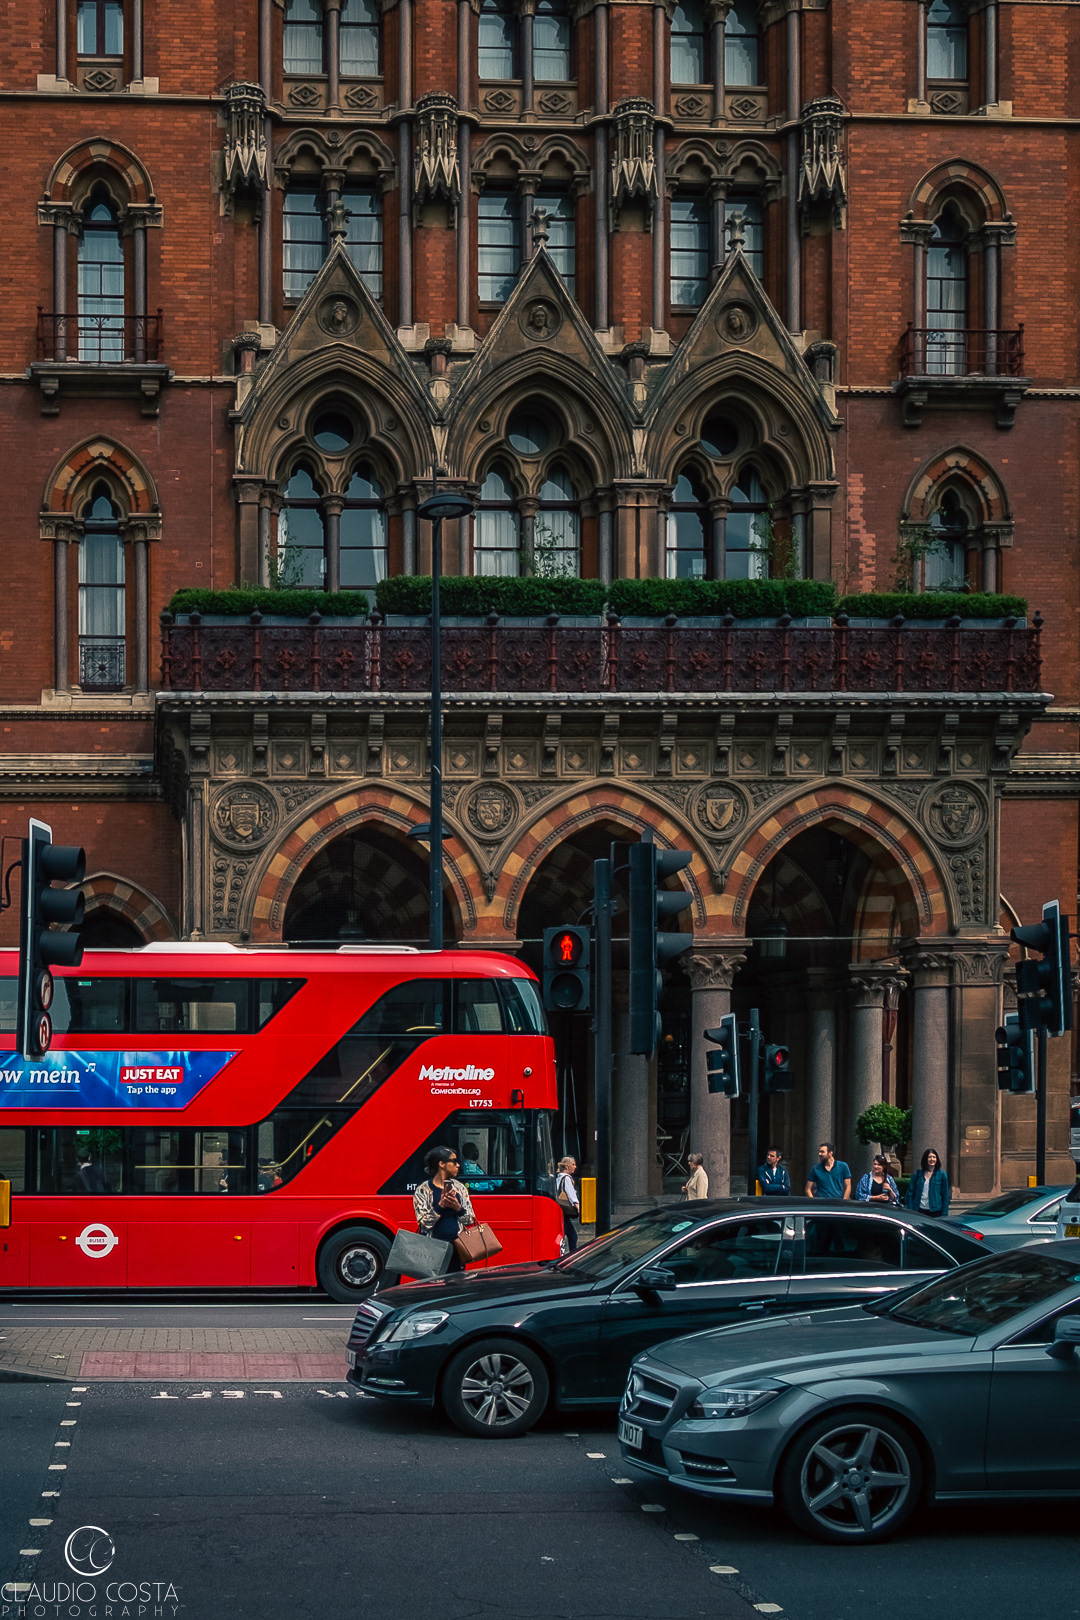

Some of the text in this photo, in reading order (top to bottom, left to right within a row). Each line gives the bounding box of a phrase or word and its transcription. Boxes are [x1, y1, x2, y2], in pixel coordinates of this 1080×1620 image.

[30, 1066, 80, 1084] mein
[122, 1068, 180, 1080] JUST EAT
[418, 1064, 495, 1080] Metroline
[127, 1085, 143, 1094] Tap
[144, 1085, 159, 1093] the
